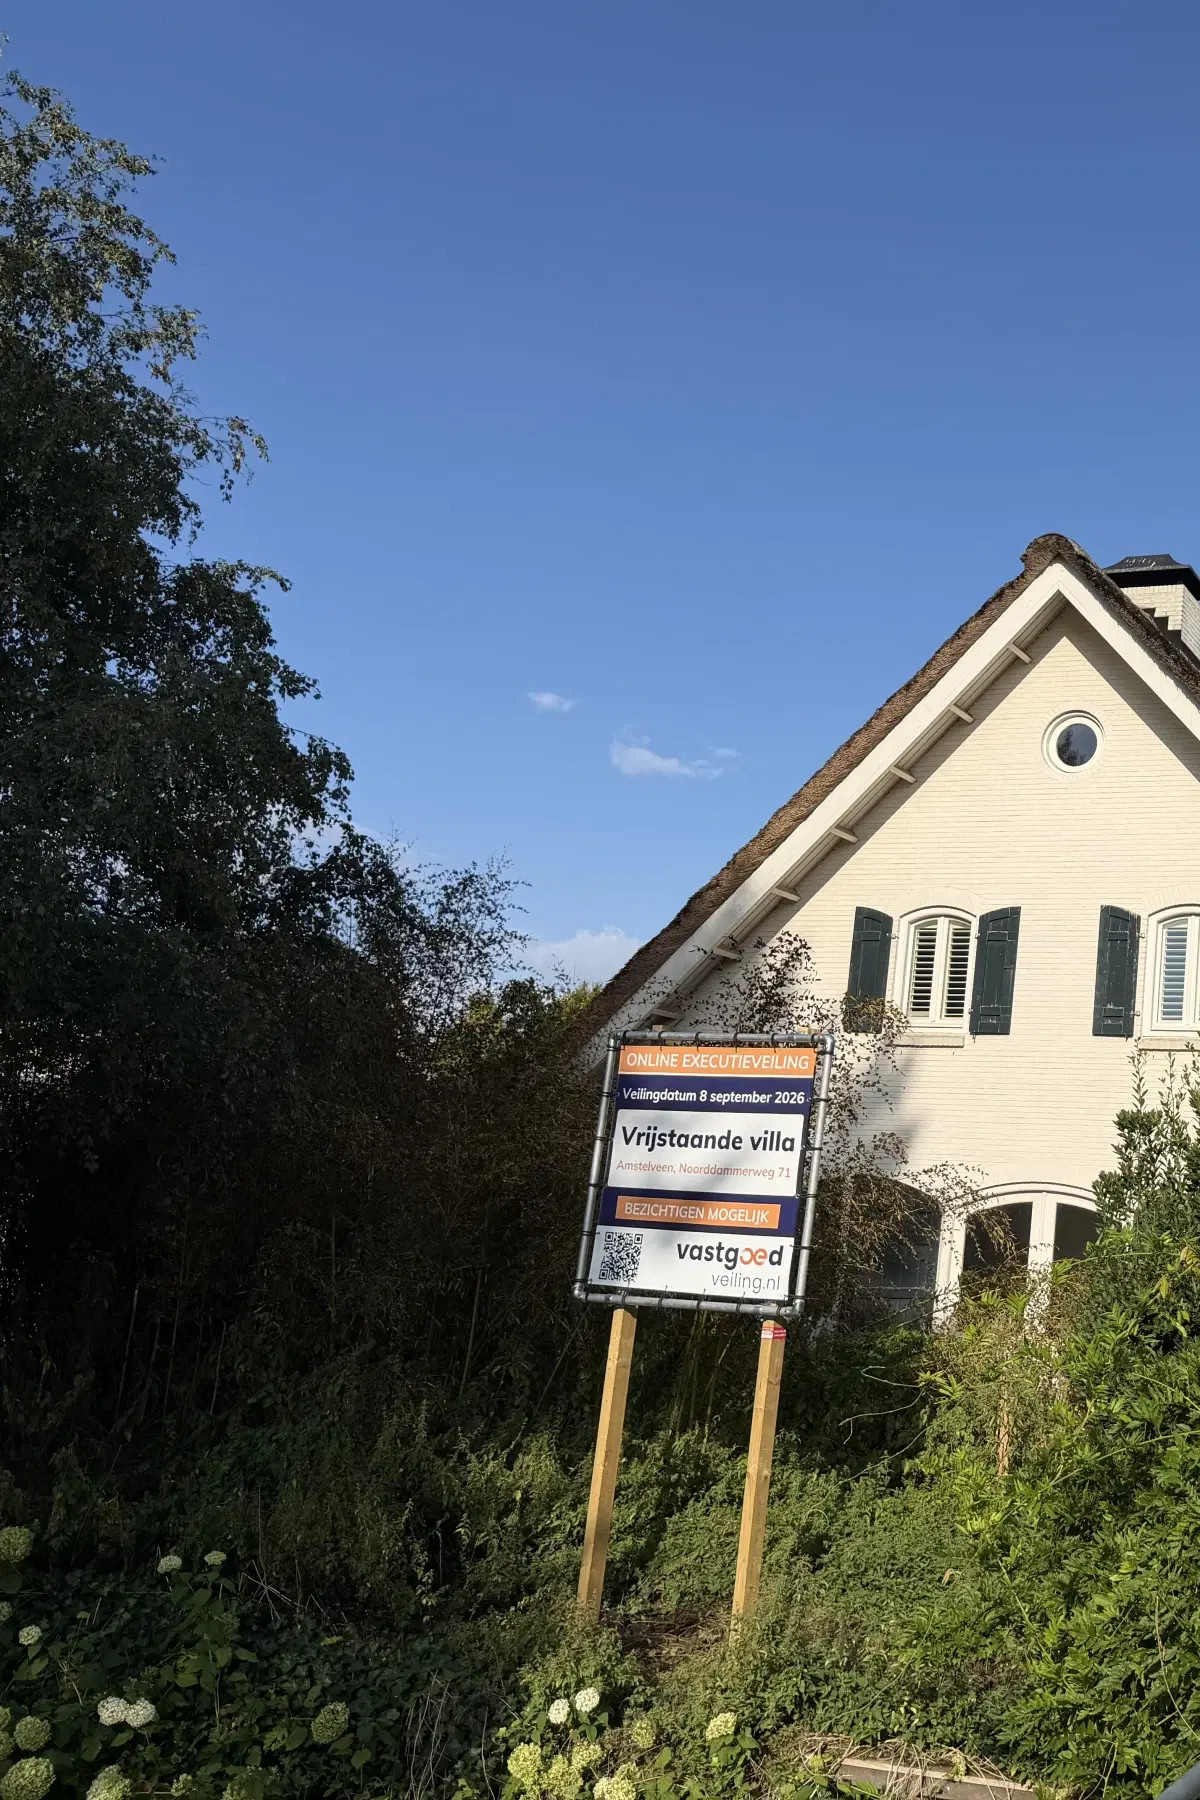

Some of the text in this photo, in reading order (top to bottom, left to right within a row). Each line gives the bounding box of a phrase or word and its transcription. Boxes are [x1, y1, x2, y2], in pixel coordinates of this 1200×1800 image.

[626, 1053, 809, 1070] ONLINE EXECUTIEVEILING
[622, 1087, 805, 1105] Veilingdatum 8 september 2026
[621, 1126, 795, 1152] Vrijstaande villa
[616, 1160, 791, 1179] Amstelveen, Noorddammerweg 71
[624, 1202, 770, 1223] BEZICHTIGEN MOGELIJK
[677, 1240, 784, 1270] vastgoed
[711, 1272, 780, 1294] veiling.nl
